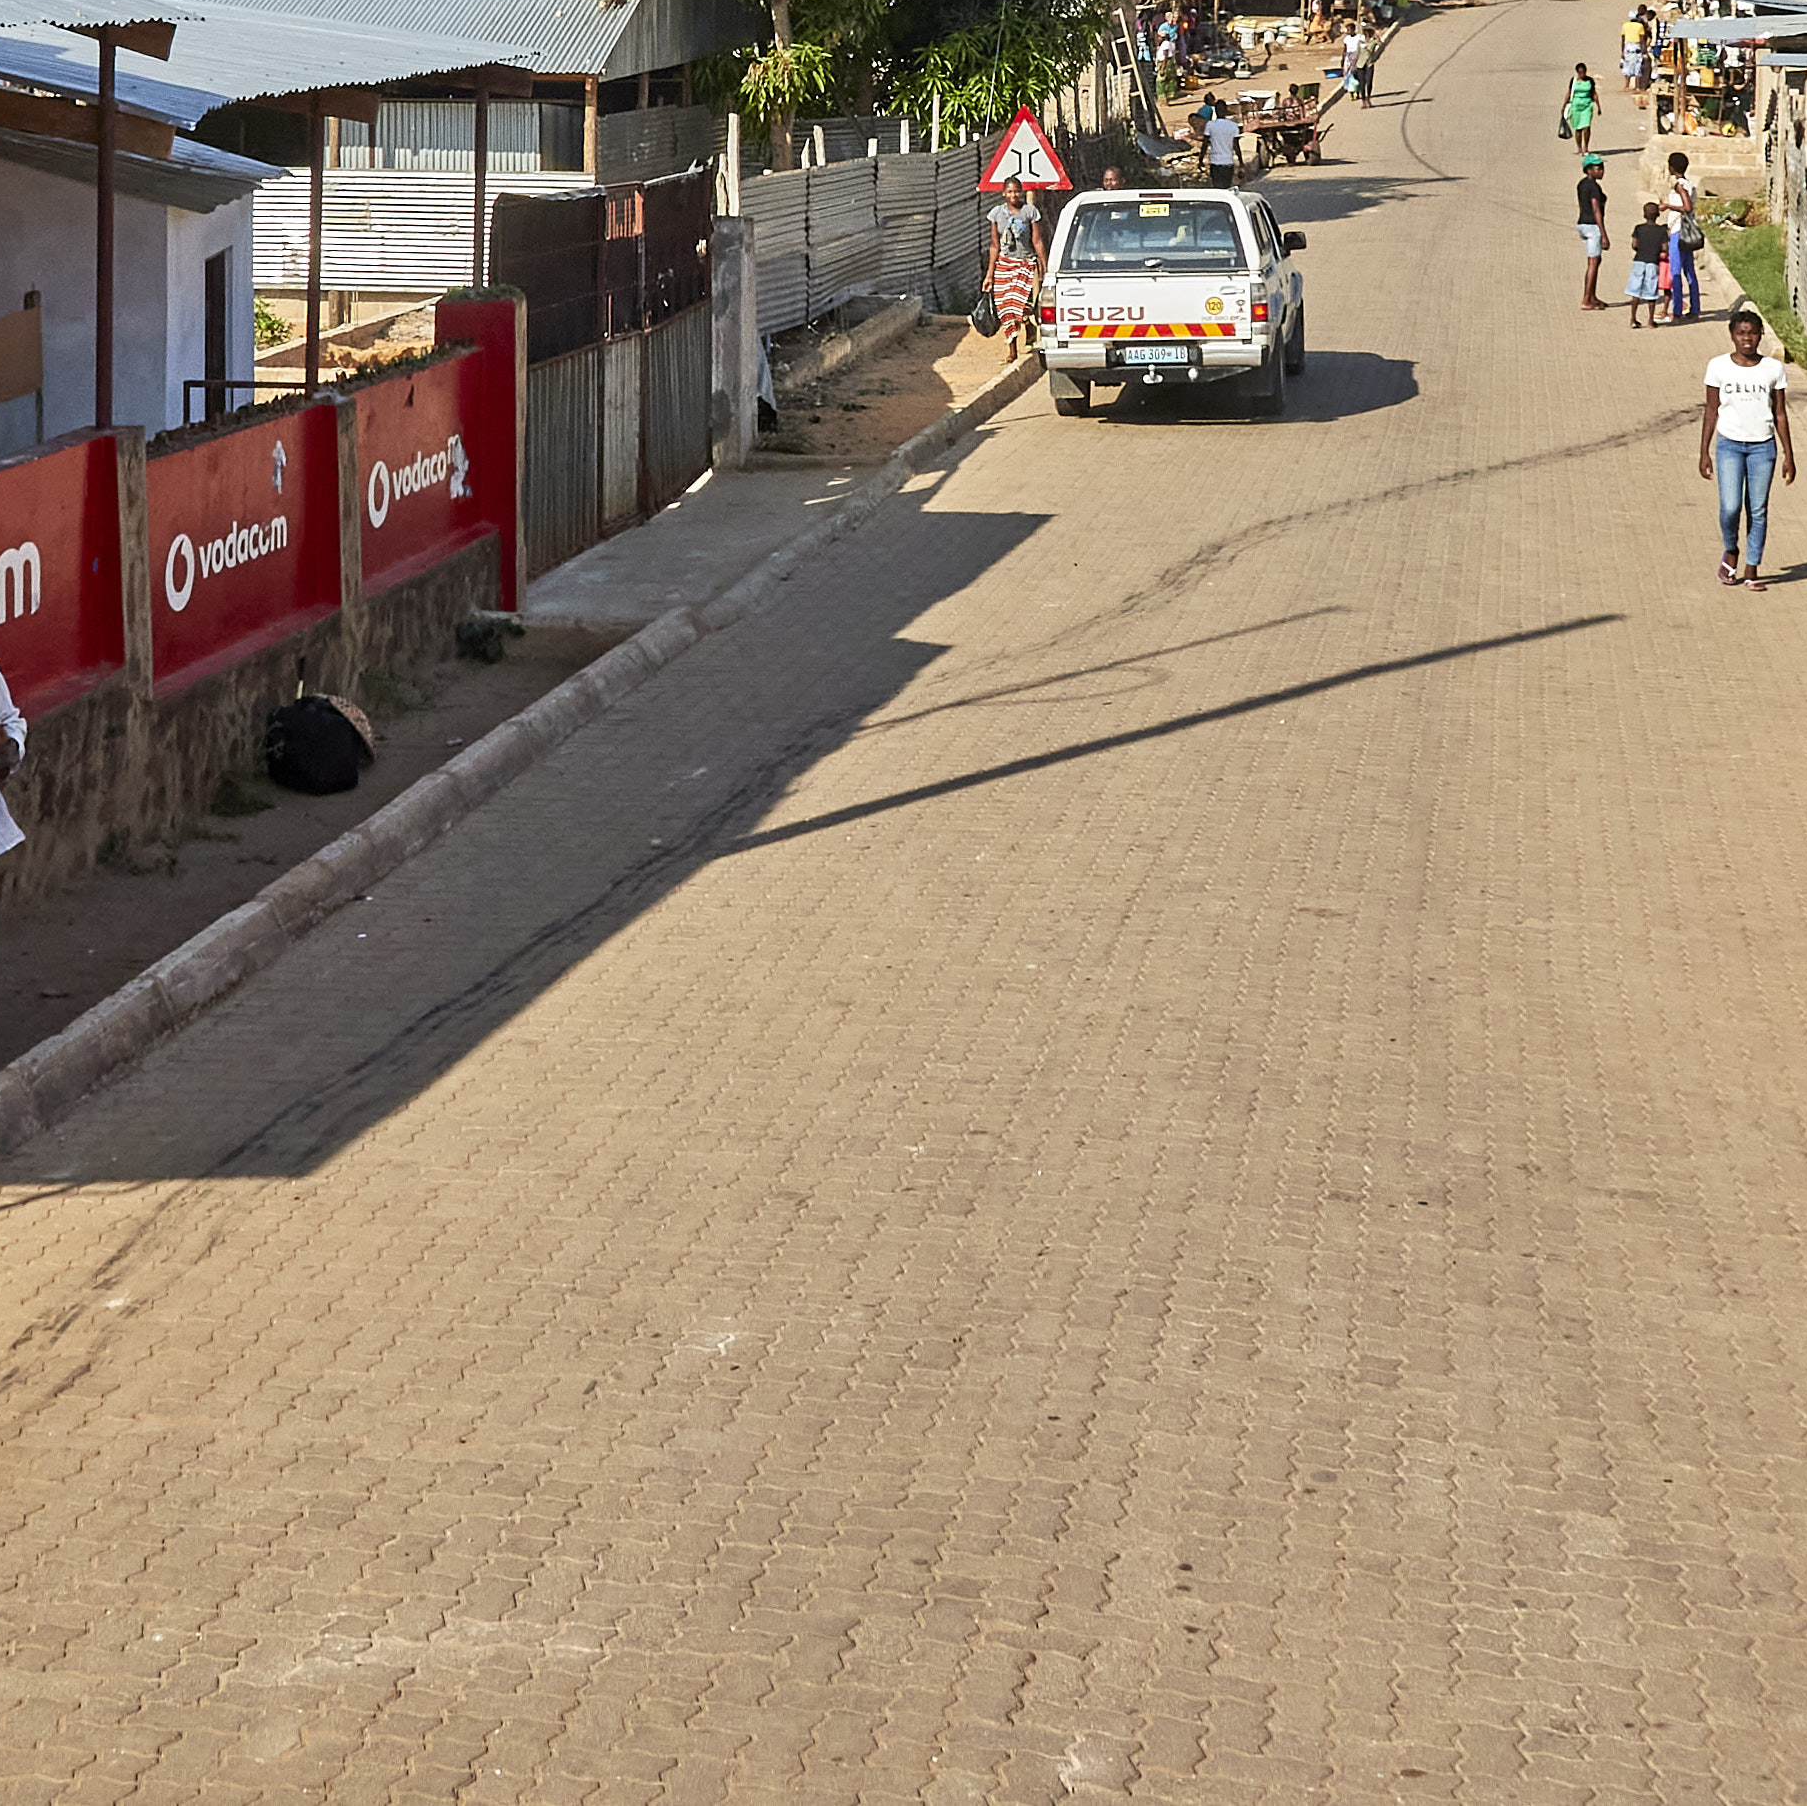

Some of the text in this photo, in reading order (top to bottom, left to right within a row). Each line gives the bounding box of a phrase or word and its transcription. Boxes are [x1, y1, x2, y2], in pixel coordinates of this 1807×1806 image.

[1060, 306, 1144, 322] ISUZU
[1128, 349, 1146, 361] AAG
[1148, 348, 1166, 360] 309
